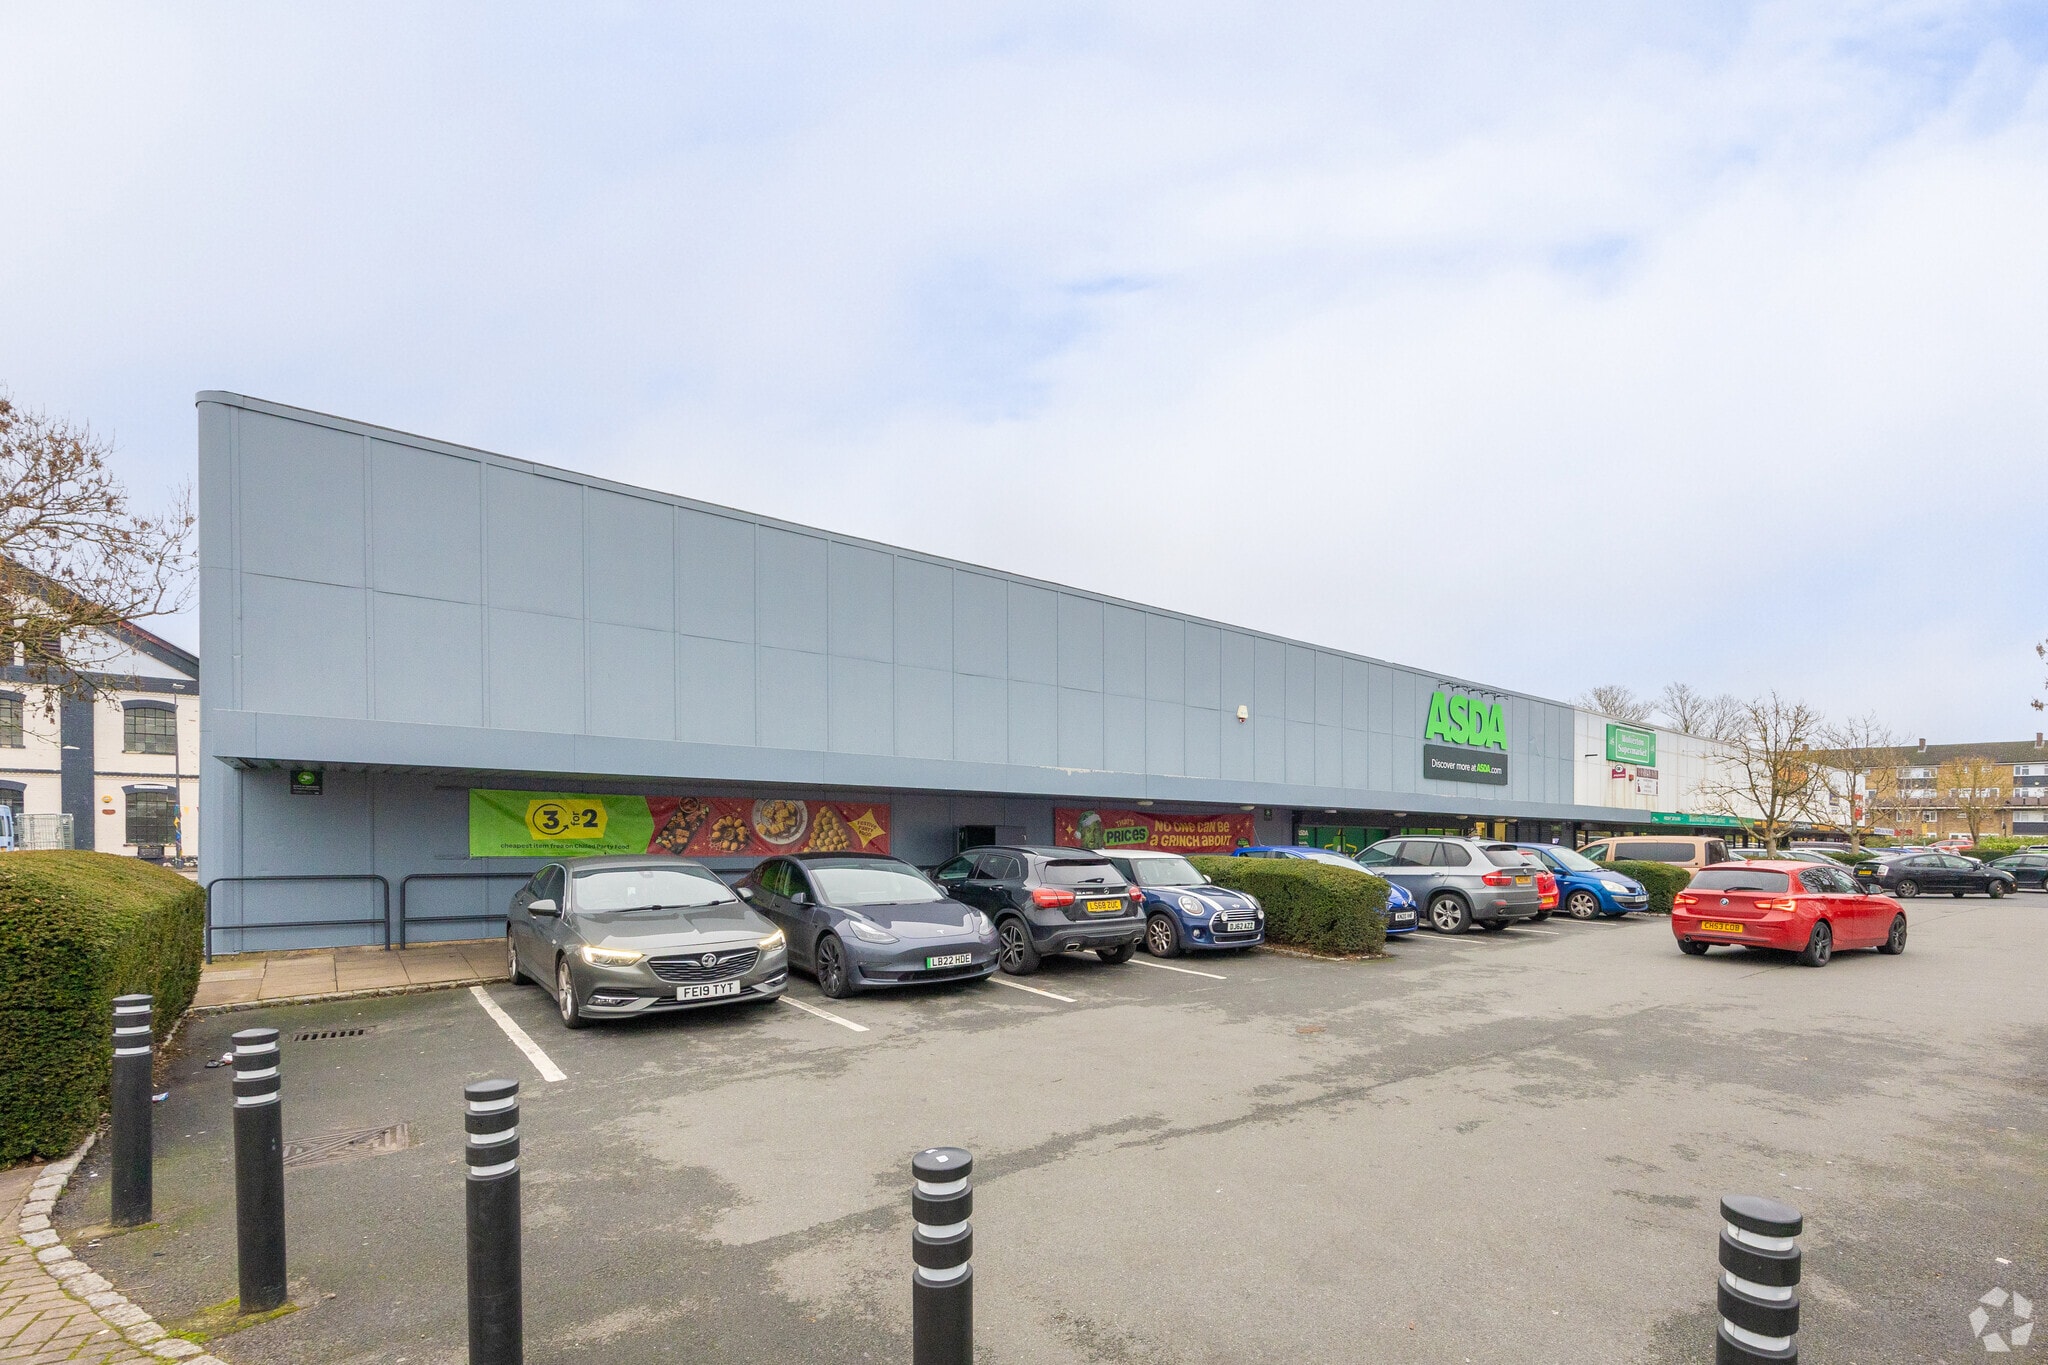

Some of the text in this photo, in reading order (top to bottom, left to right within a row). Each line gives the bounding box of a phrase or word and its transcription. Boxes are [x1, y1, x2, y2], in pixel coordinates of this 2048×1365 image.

[1425, 691, 1508, 750] ASDA
[1431, 758, 1456, 770] Discover
[1456, 763, 1471, 771] more
[1471, 764, 1477, 772] at
[543, 808, 599, 829] 3 for 2
[1154, 820, 1172, 832] NO
[500, 842, 532, 850] cheapest
[932, 954, 970, 967] LB22 HDE
[684, 982, 734, 998] FE19 TYT
